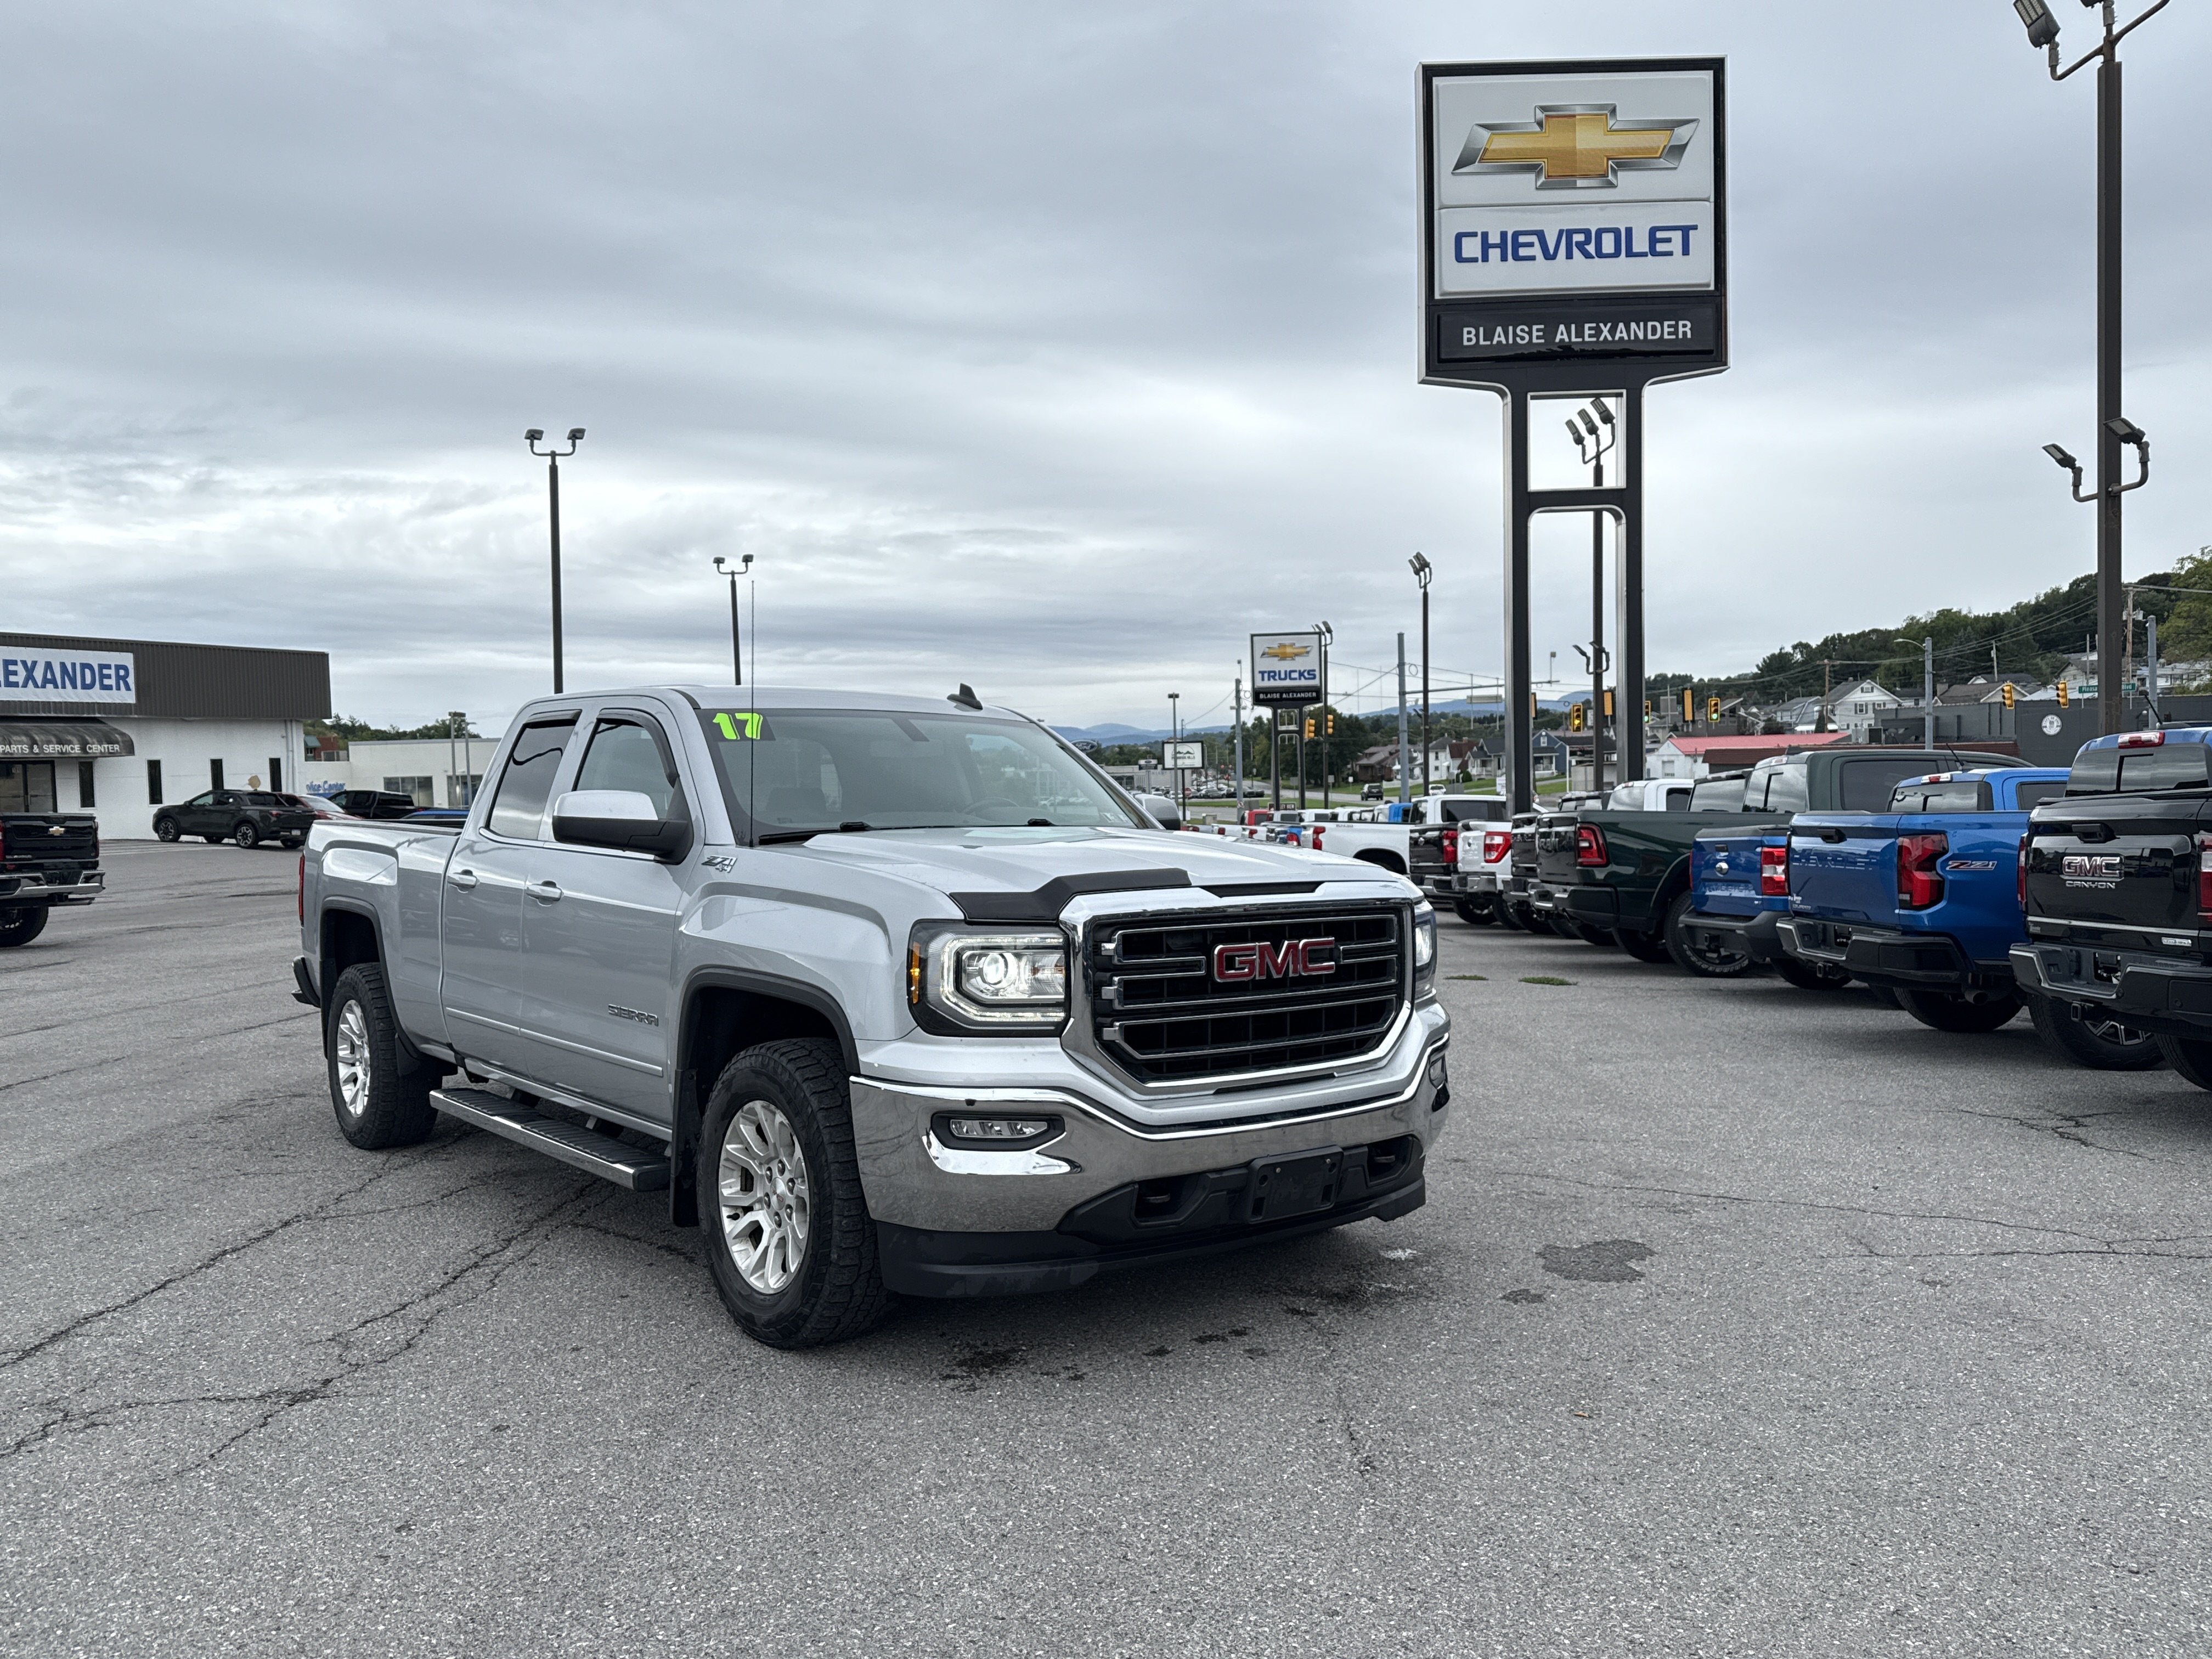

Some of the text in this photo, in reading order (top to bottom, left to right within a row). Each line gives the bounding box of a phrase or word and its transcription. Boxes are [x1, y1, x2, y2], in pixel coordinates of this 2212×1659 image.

[1454, 224, 1699, 263] CHEVROLET
[1463, 320, 1692, 346] BLAISE ALEXANDER
[0, 659, 131, 691] EXANDER
[1259, 669, 1317, 681] TRUCKS
[713, 713, 763, 740] 17
[0, 744, 120, 753] PARTS & SERVICE CENTER
[701, 855, 737, 867] Z71
[2062, 856, 2121, 877] GMC
[2066, 881, 2116, 889] CANYON
[1214, 936, 1336, 983] GMC
[608, 1003, 659, 1027] SIERRA
